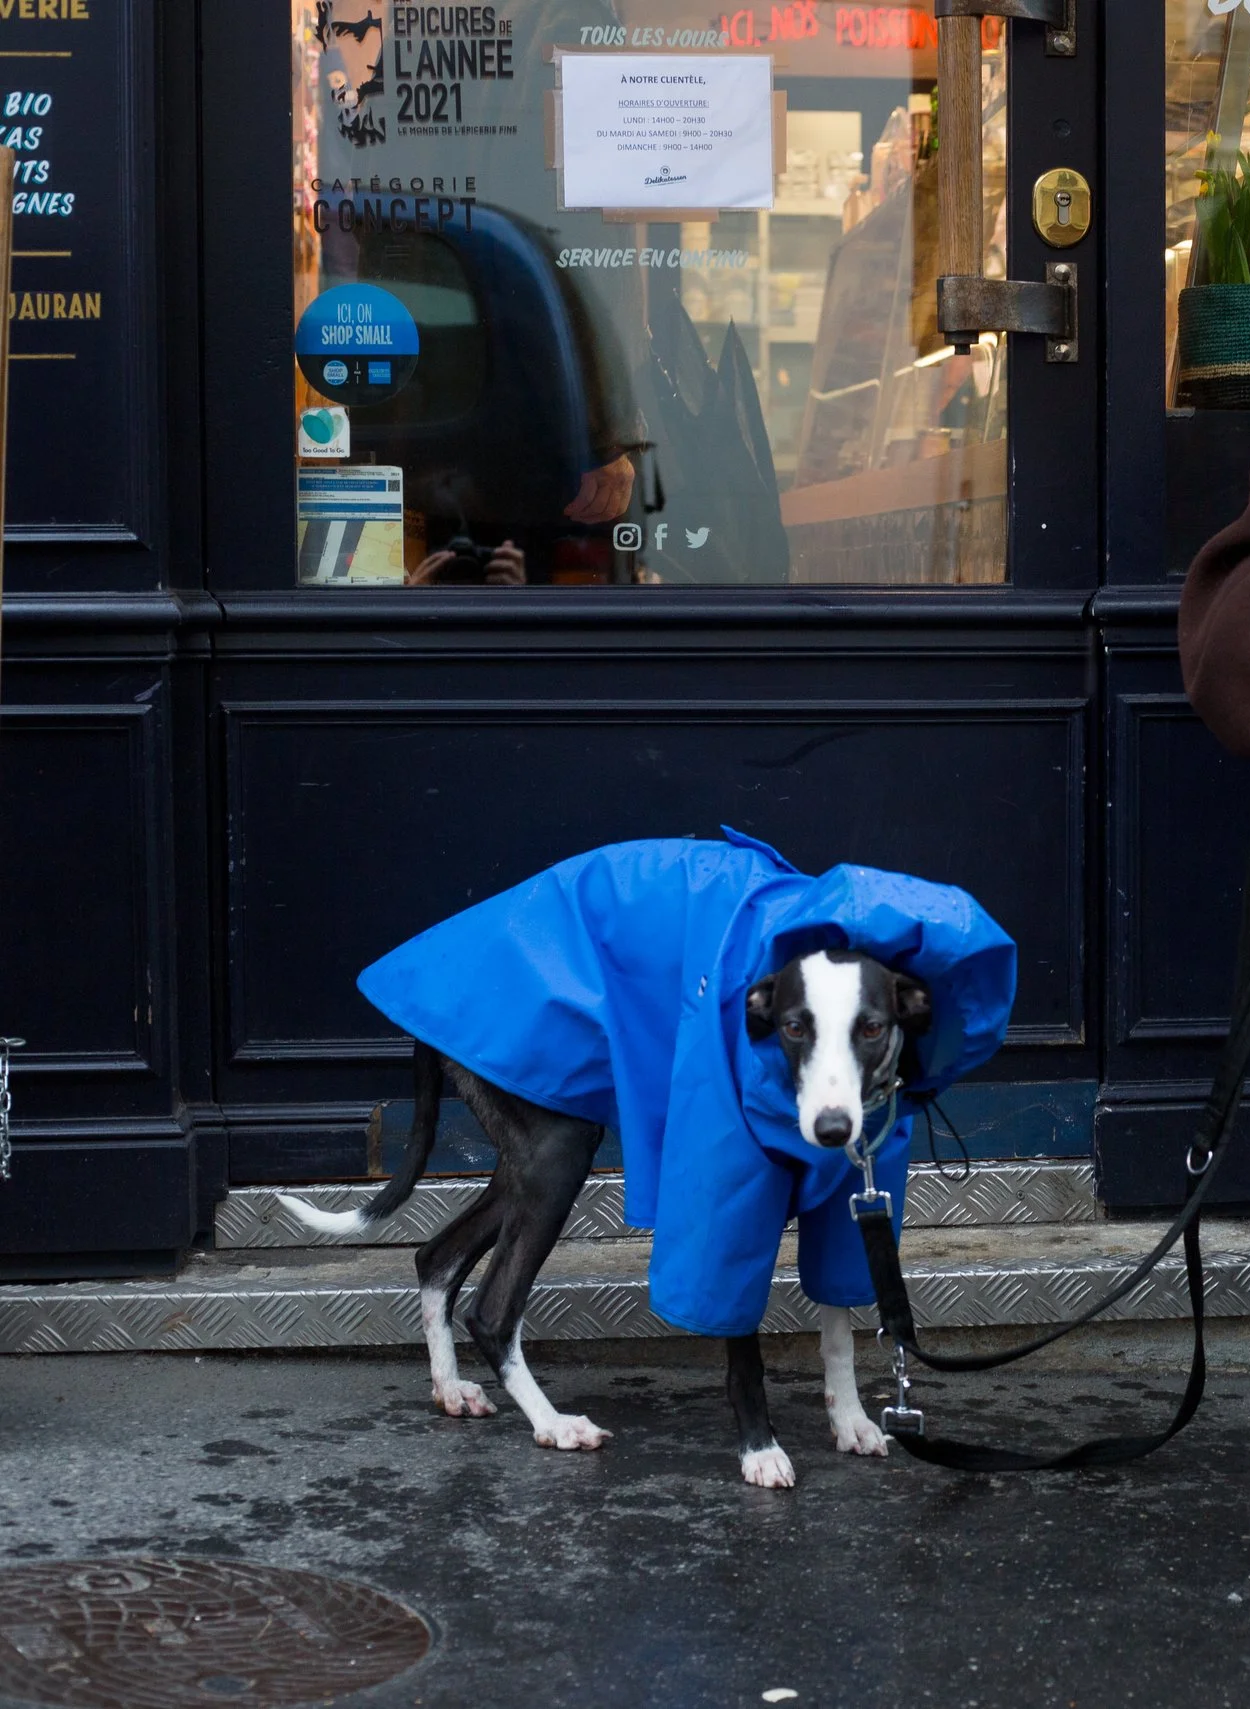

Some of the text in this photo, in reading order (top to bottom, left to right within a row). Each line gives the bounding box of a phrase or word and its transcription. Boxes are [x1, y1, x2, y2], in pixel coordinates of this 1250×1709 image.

[580, 25, 730, 48] TOUS LES JOURS
[620, 74, 707, 85] À NOTRE CLIENTÈLE,
[3, 91, 52, 116] BIO
[396, 82, 462, 123] 2021
[618, 100, 655, 108] HORAIRES
[311, 174, 477, 194] CATÉGORIE
[313, 197, 477, 234] CONCEPT
[555, 247, 749, 268] SERVICE EN CONTINU
[337, 303, 372, 325] ICI, ON
[321, 325, 393, 345] SHOP SMALL
